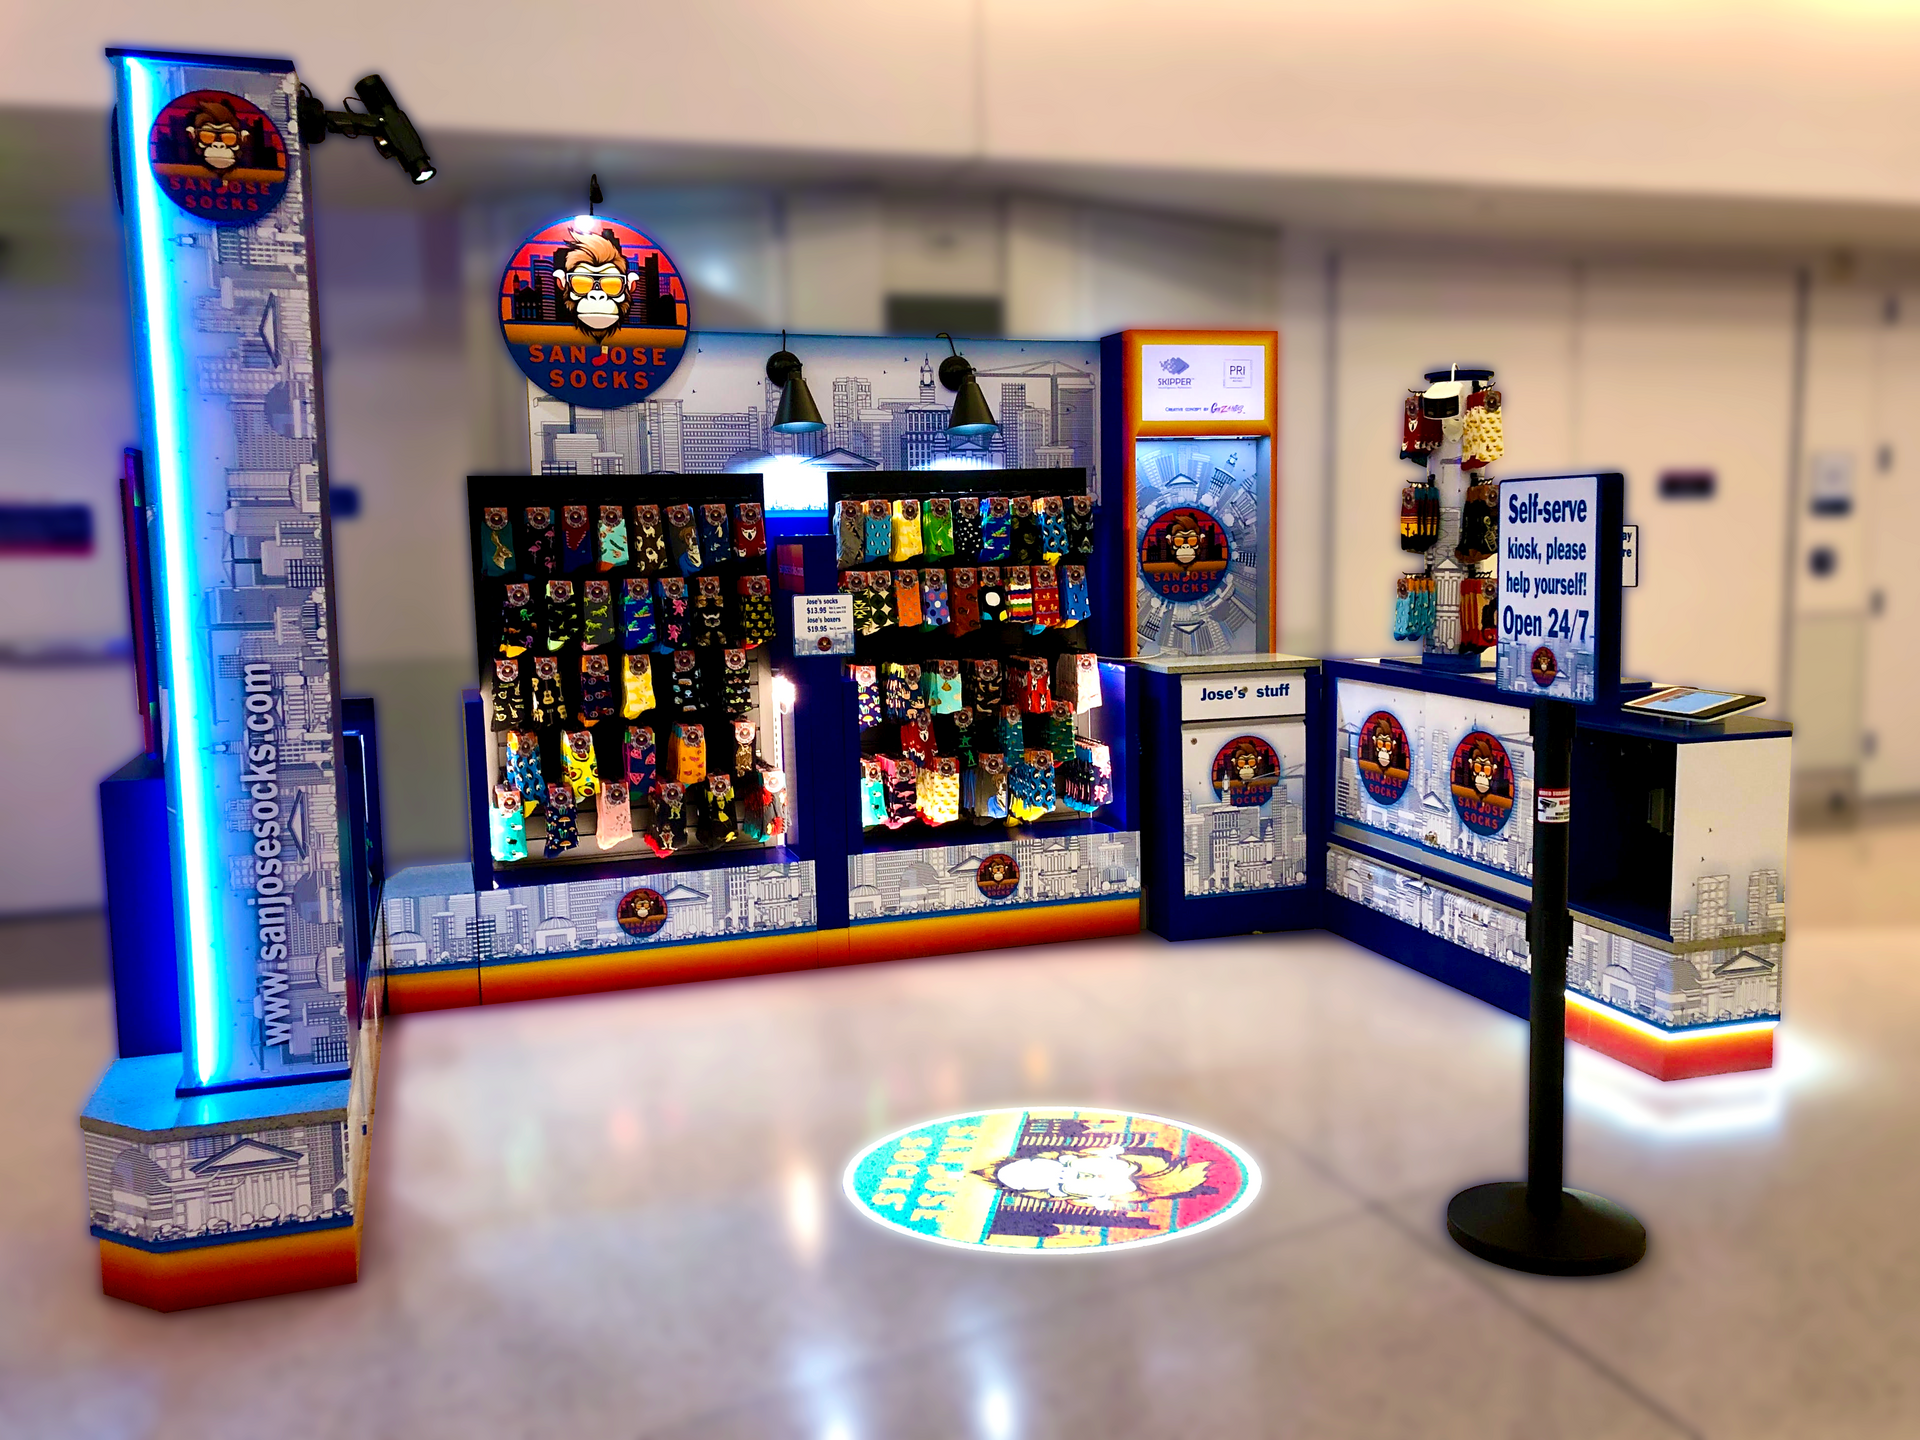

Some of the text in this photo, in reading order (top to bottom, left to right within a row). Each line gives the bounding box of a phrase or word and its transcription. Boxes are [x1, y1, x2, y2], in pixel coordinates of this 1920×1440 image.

[169, 176, 212, 192] SAN
[185, 195, 258, 211] SOCKS
[529, 344, 666, 366] SAN JOSE
[549, 369, 649, 389] SOCKS
[1158, 366, 1245, 386] SKIPPER PRI
[1508, 493, 1587, 524] Self-serve
[1507, 536, 1586, 565] kiosk, please
[1154, 572, 1180, 581] SAN
[1506, 570, 1587, 599] help yourself!
[1162, 584, 1208, 593] SOCKS
[1503, 605, 1589, 643] Open 24/7
[1200, 683, 1290, 701] Jose's stuff
[1364, 771, 1381, 784] SAN
[1369, 783, 1397, 800] SOCKS
[1458, 796, 1478, 811] SAN
[1464, 811, 1499, 830] SOCKS
[239, 663, 292, 1047] www.sanjosesocks.com
